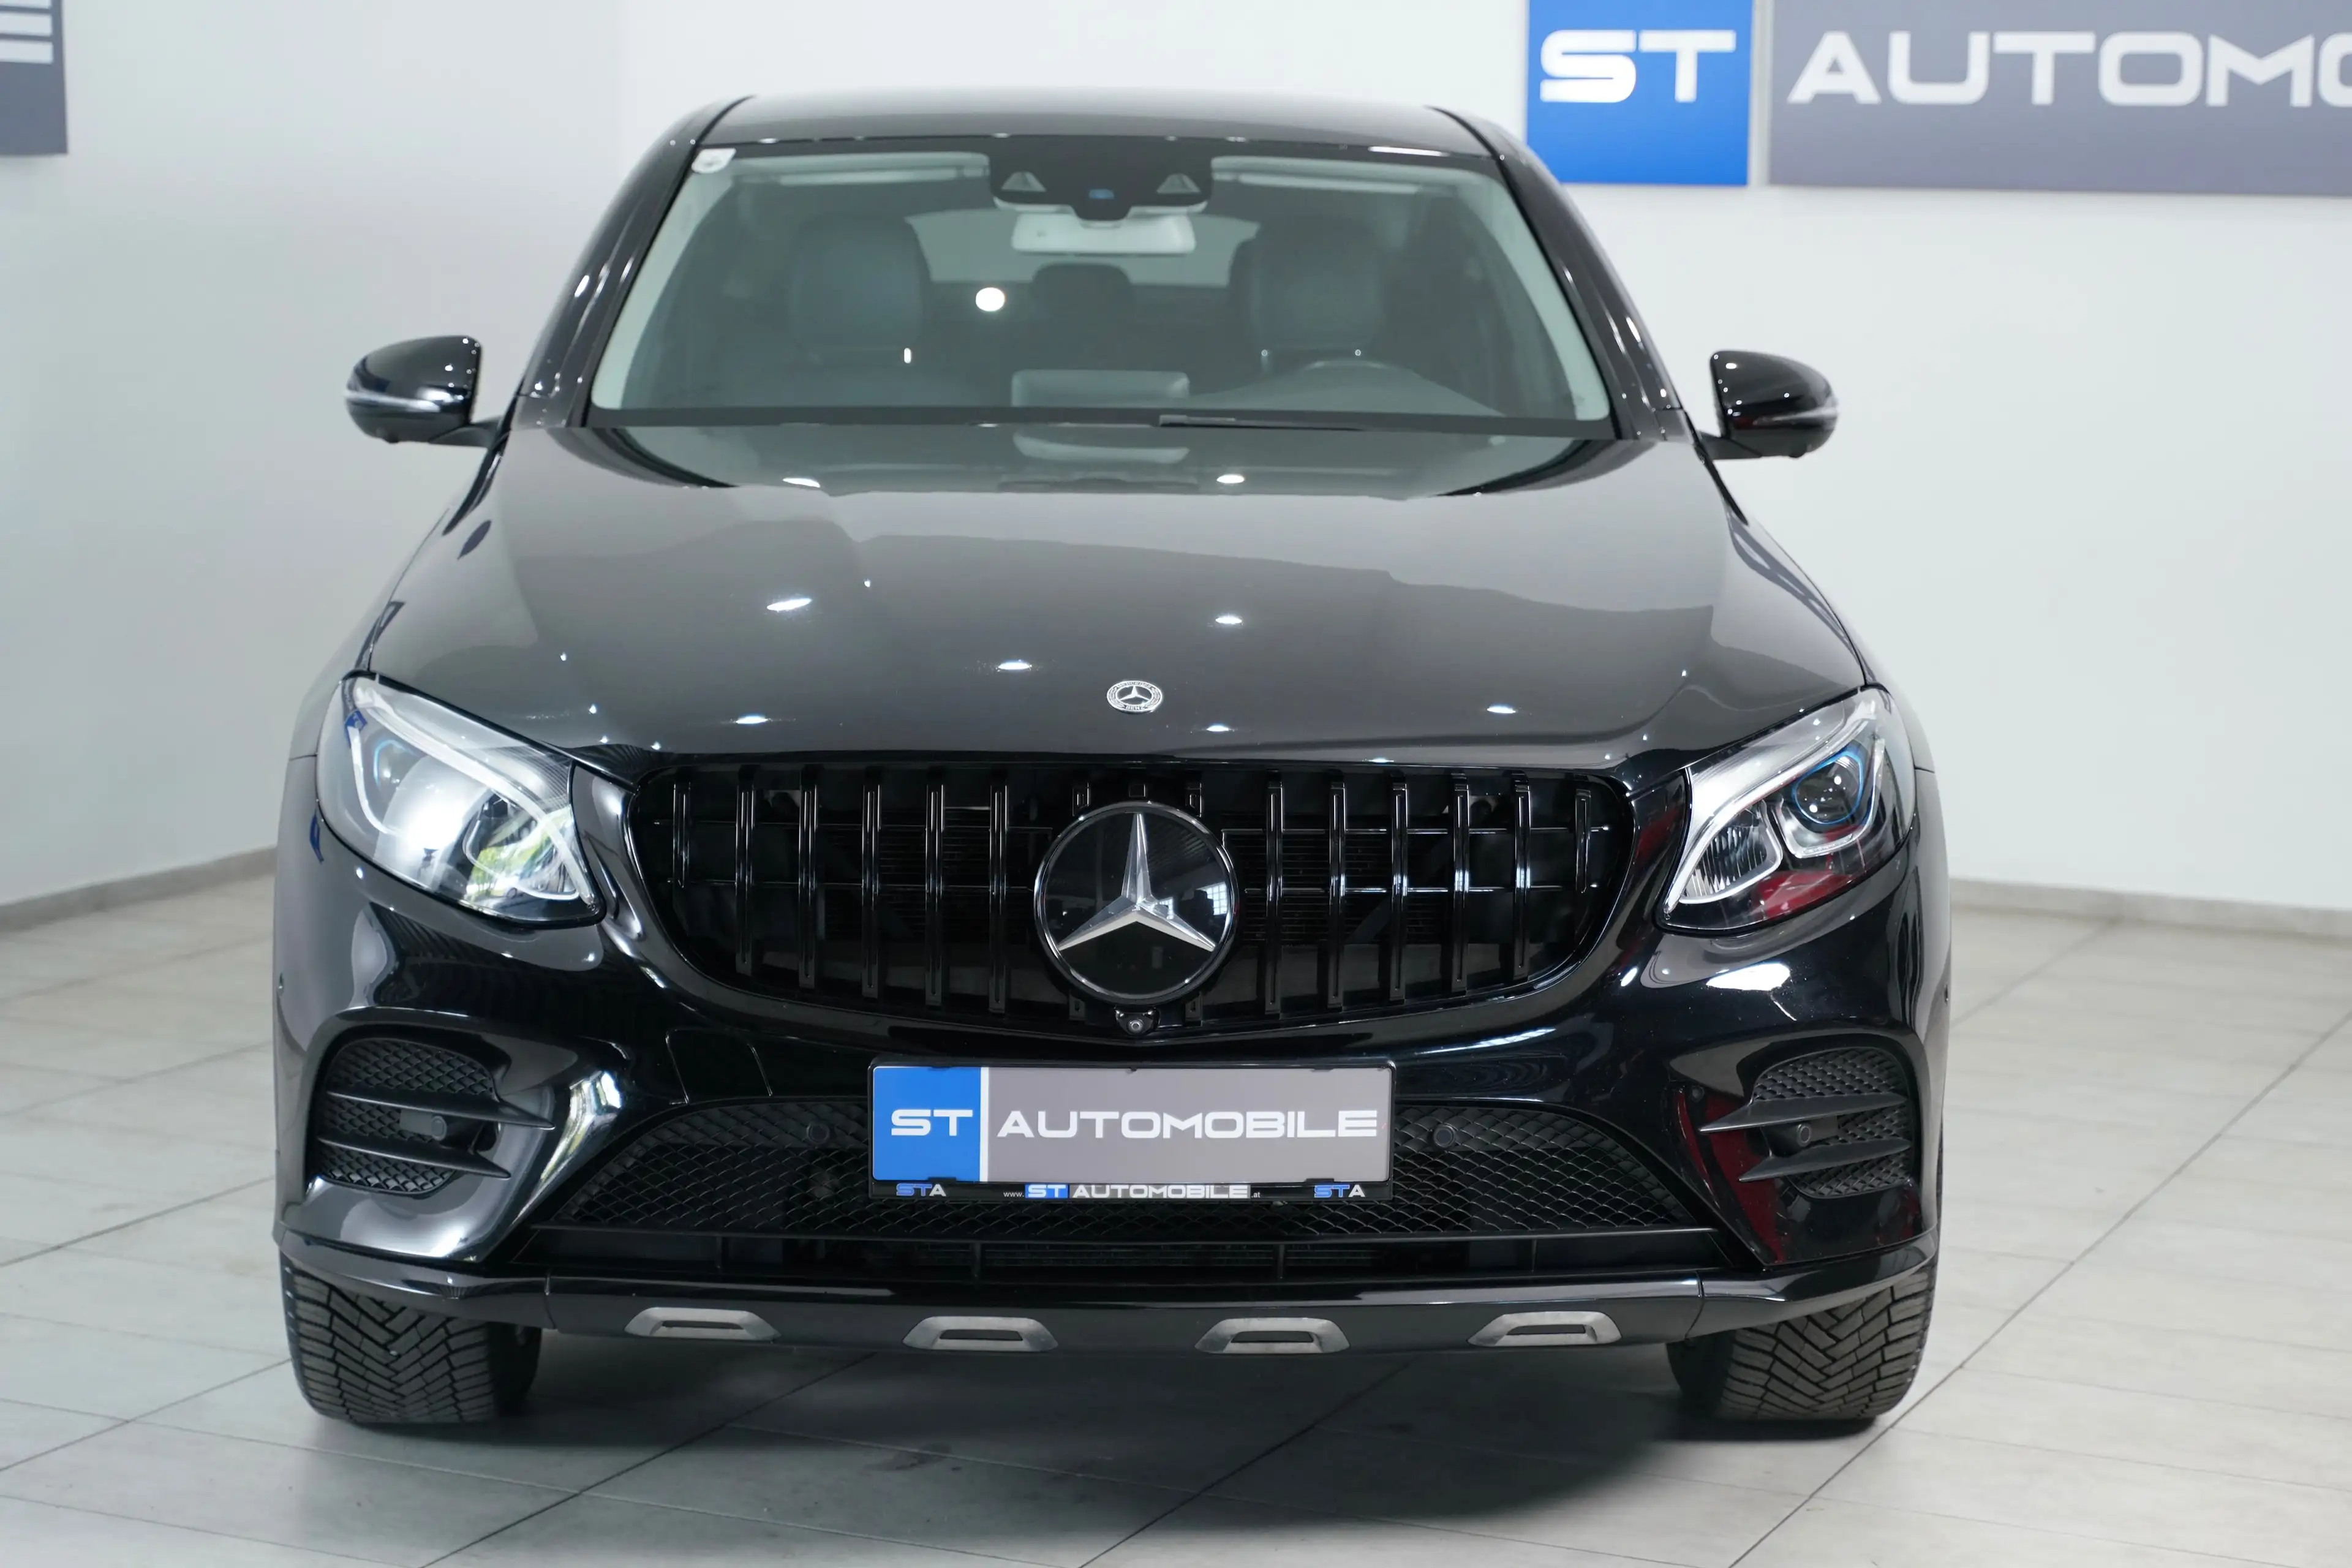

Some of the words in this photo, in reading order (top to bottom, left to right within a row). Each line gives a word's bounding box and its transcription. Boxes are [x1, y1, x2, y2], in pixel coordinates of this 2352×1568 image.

[1540, 30, 1736, 103] ST
[891, 1109, 973, 1136] ST
[997, 1110, 1377, 1138] AUTOMOBILE
[896, 1183, 946, 1197] STA
[1028, 1184, 1066, 1198] ST
[1072, 1184, 1248, 1199] AUTOMOBILE
[1314, 1184, 1365, 1198] STA
